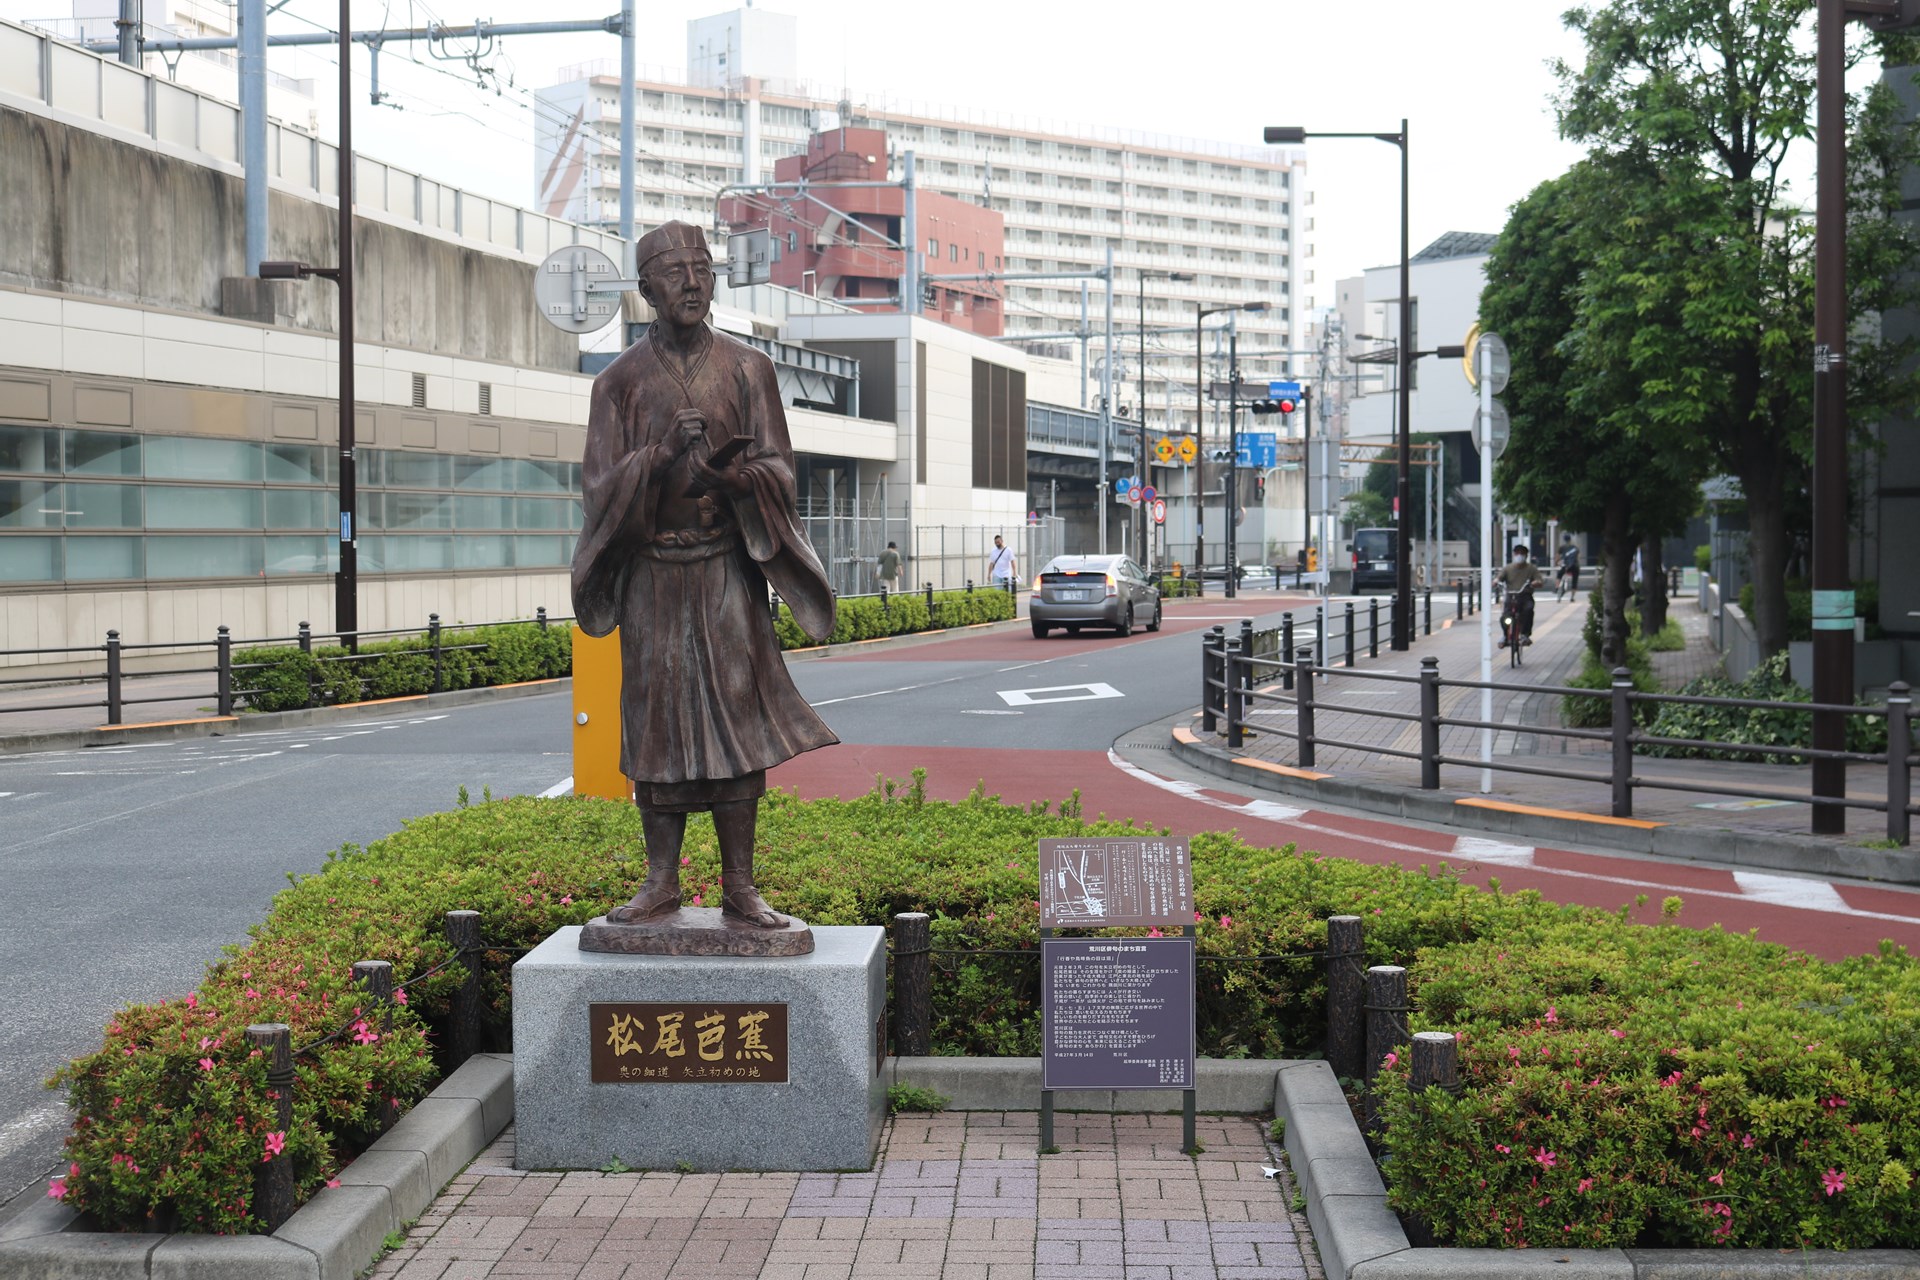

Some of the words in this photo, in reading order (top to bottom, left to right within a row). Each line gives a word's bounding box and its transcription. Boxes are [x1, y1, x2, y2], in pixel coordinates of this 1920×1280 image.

[1180, 900, 1186, 910] 千住
[606, 1009, 774, 1062] 松尾芭蕉
[619, 1065, 670, 1078] 奥の細道
[682, 1066, 761, 1078] 矢立初めの地
